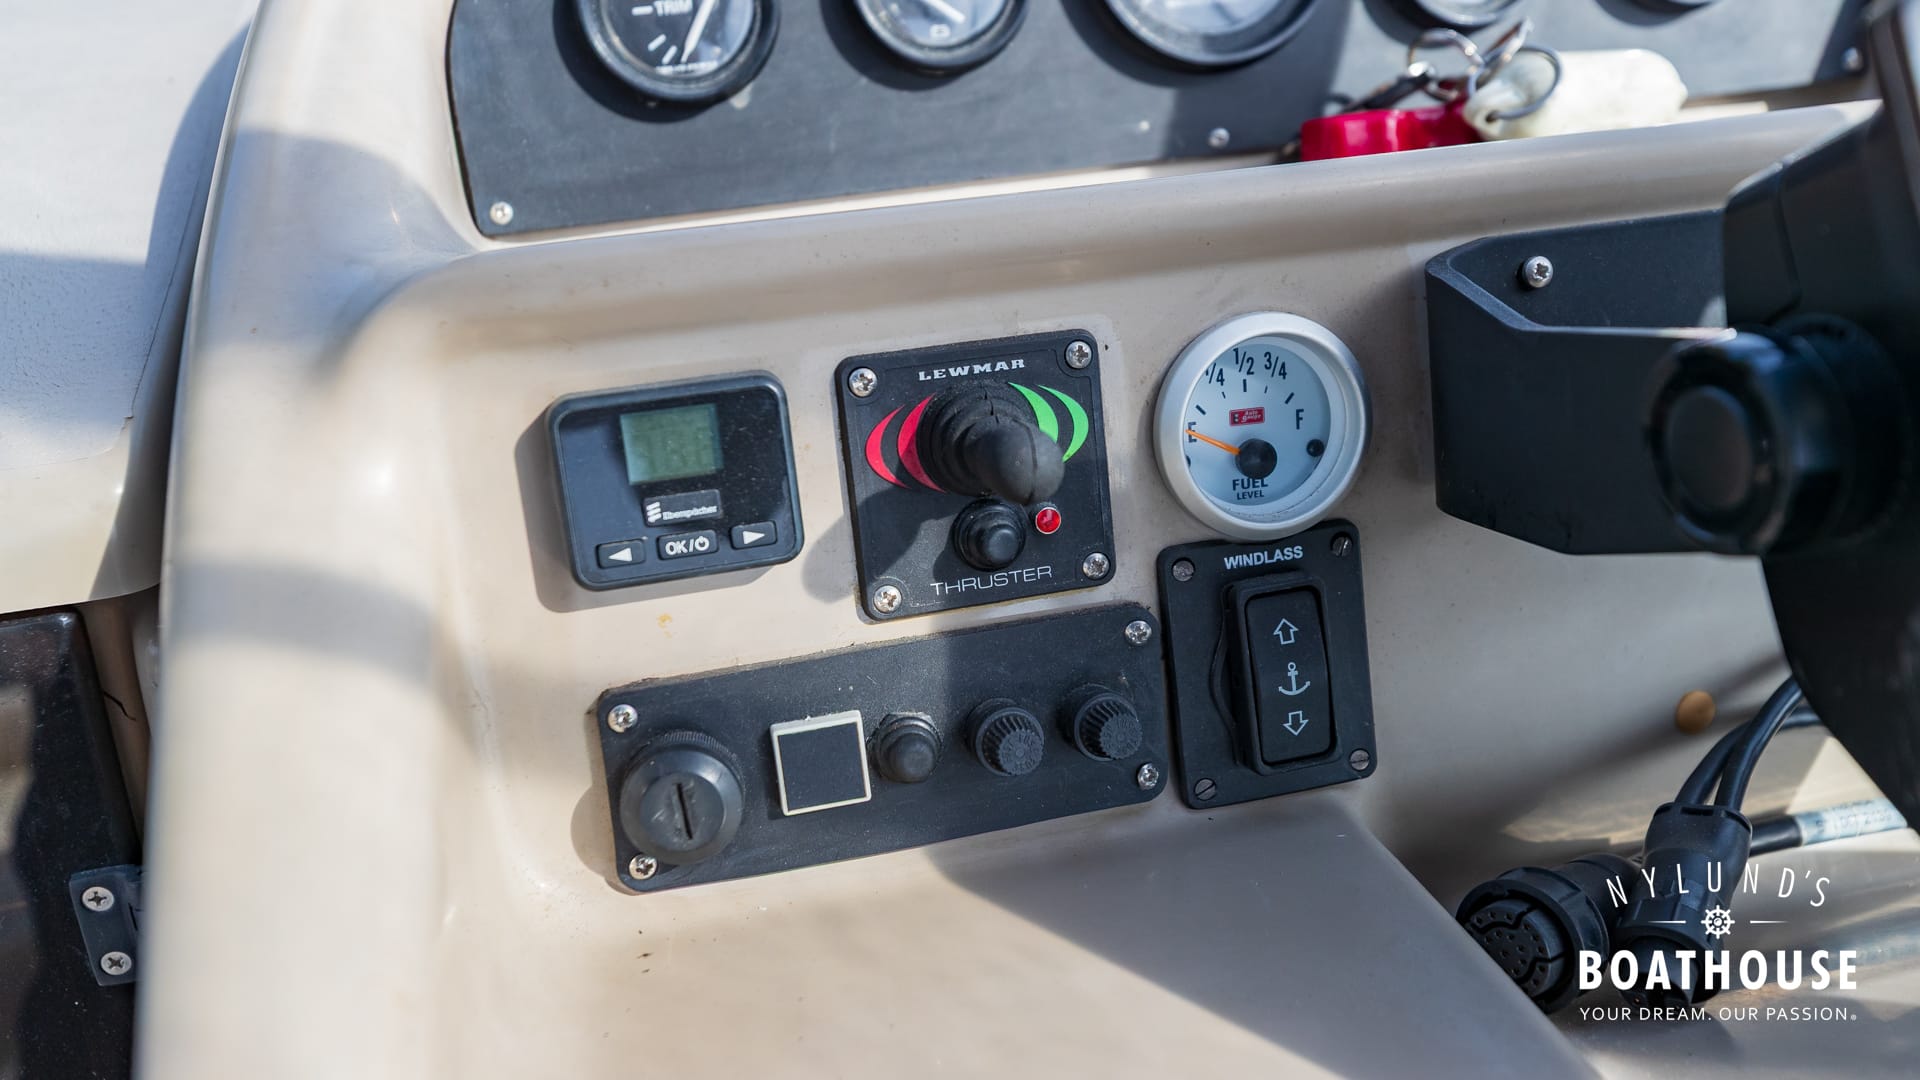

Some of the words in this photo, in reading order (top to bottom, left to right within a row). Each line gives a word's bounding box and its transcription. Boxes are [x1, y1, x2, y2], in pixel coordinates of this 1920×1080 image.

[918, 358, 1026, 382] LEWMAR
[1233, 348, 1255, 376] 1/2
[1264, 351, 1288, 380] 3/4
[1295, 408, 1304, 431] F
[1188, 421, 1198, 443] E
[1232, 478, 1269, 491] FUEL
[1236, 489, 1265, 501] LEVEL
[1224, 545, 1304, 571] WINDLASS
[929, 565, 1053, 597] THRUSTER
